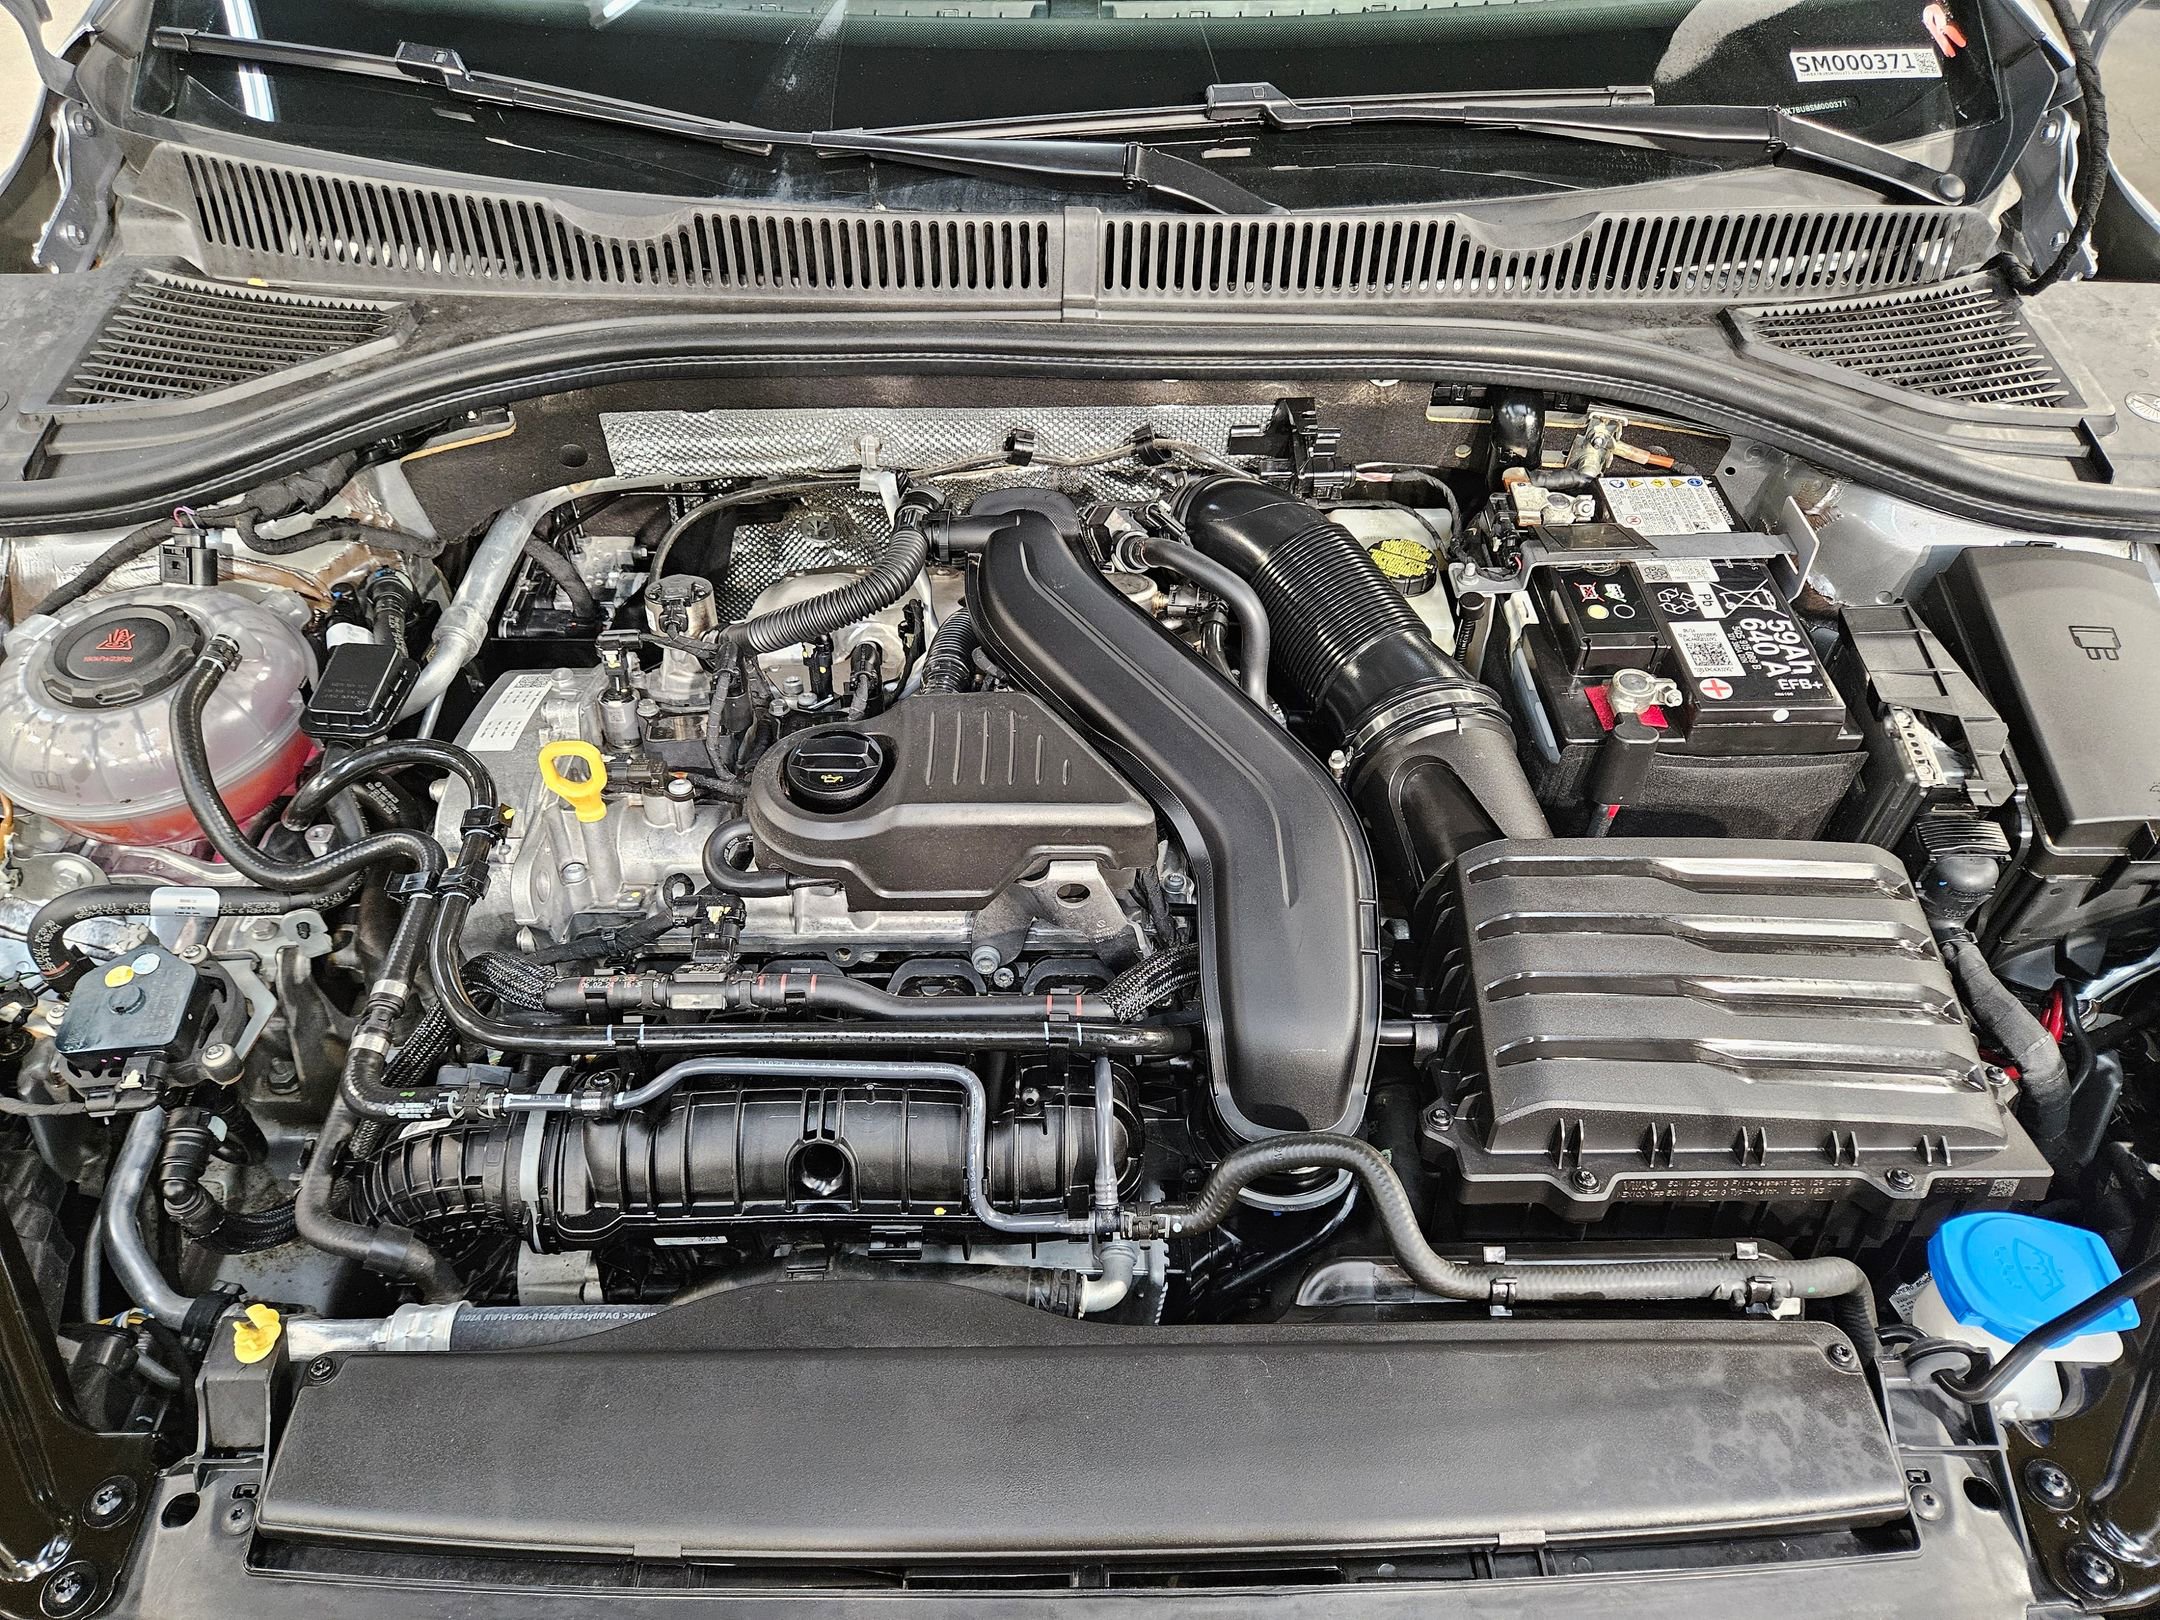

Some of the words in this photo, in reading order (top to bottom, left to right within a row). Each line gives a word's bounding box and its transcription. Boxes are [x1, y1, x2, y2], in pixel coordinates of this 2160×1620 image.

[1796, 53, 1916, 73] SM000371
[1700, 593, 1714, 607] Pb
[1739, 618, 1780, 656] 640
[1760, 660, 1792, 678] A
[1766, 619, 1817, 675] 59Ah
[1777, 678, 1824, 691] EFB+
